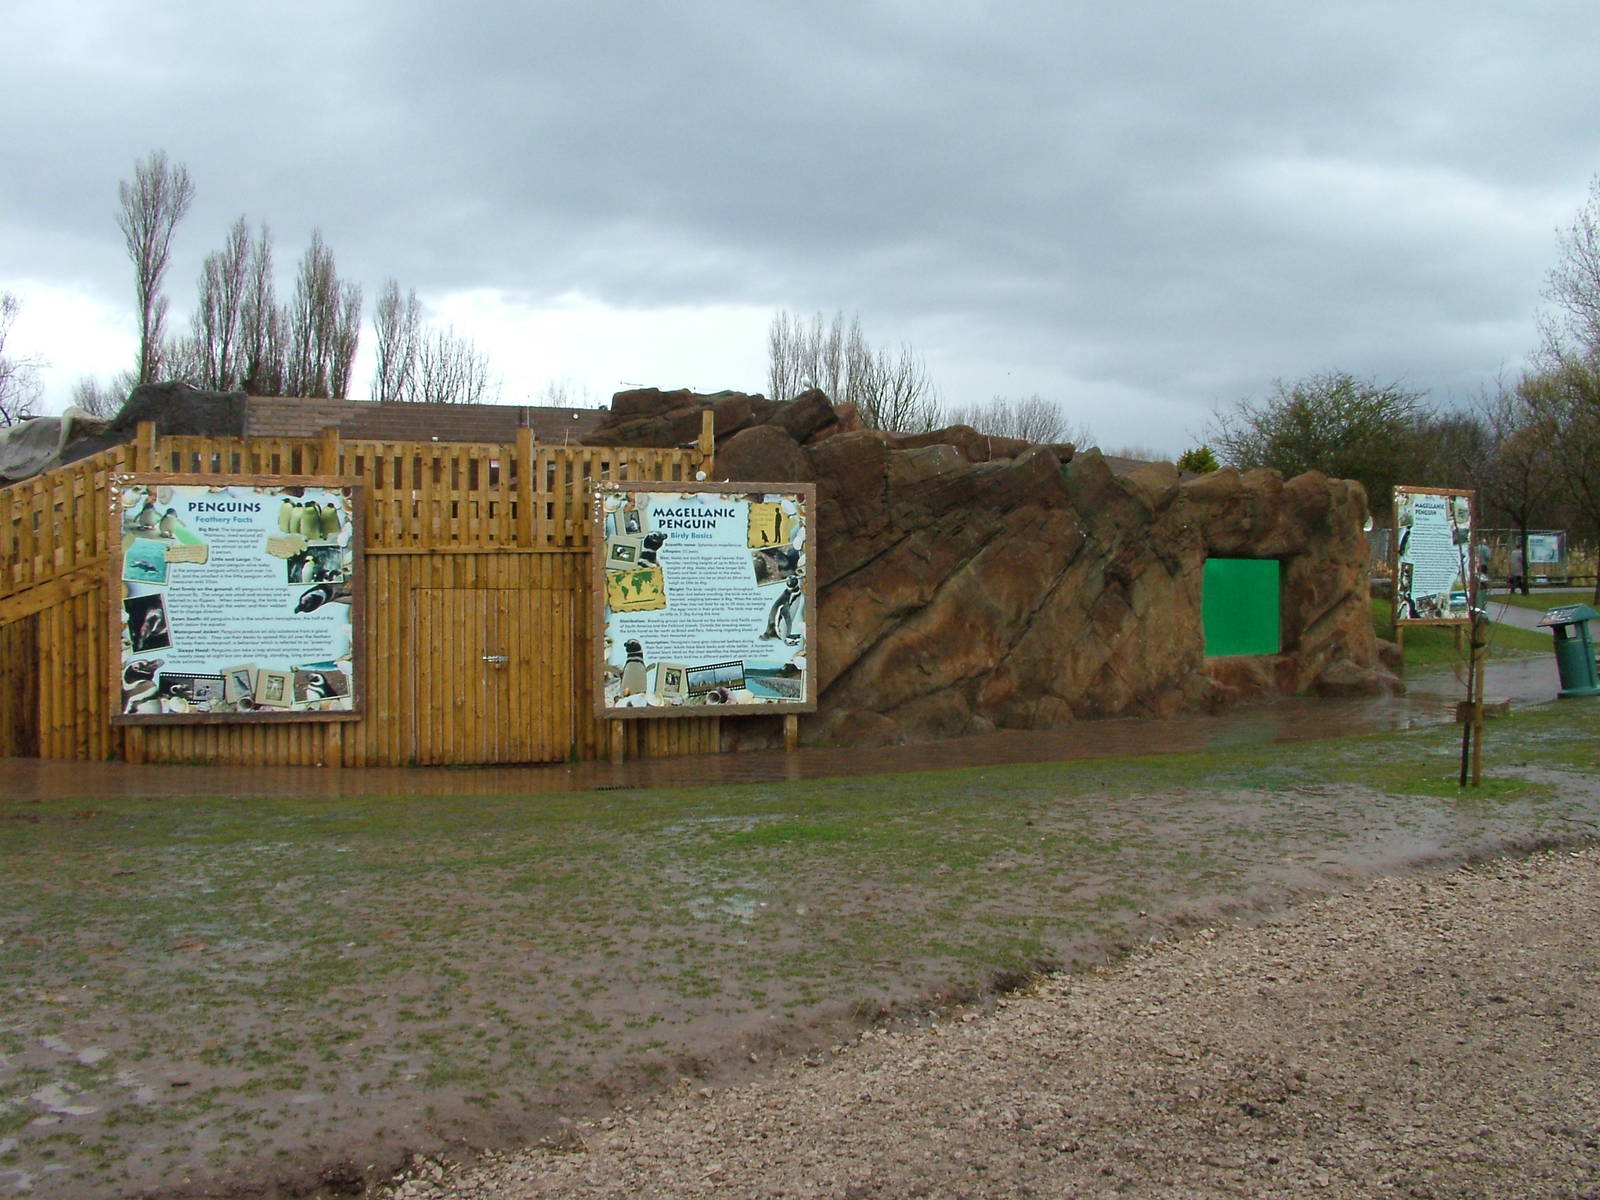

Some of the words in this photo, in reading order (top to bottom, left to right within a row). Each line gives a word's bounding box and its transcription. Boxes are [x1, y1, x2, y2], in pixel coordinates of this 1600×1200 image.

[188, 502, 261, 512] PENGUINS
[653, 508, 735, 518] MAGELLANIC
[195, 515, 230, 524] Feathery
[233, 515, 253, 523] Facts
[659, 519, 716, 529] PENGUIN
[671, 532, 689, 540] Birdy
